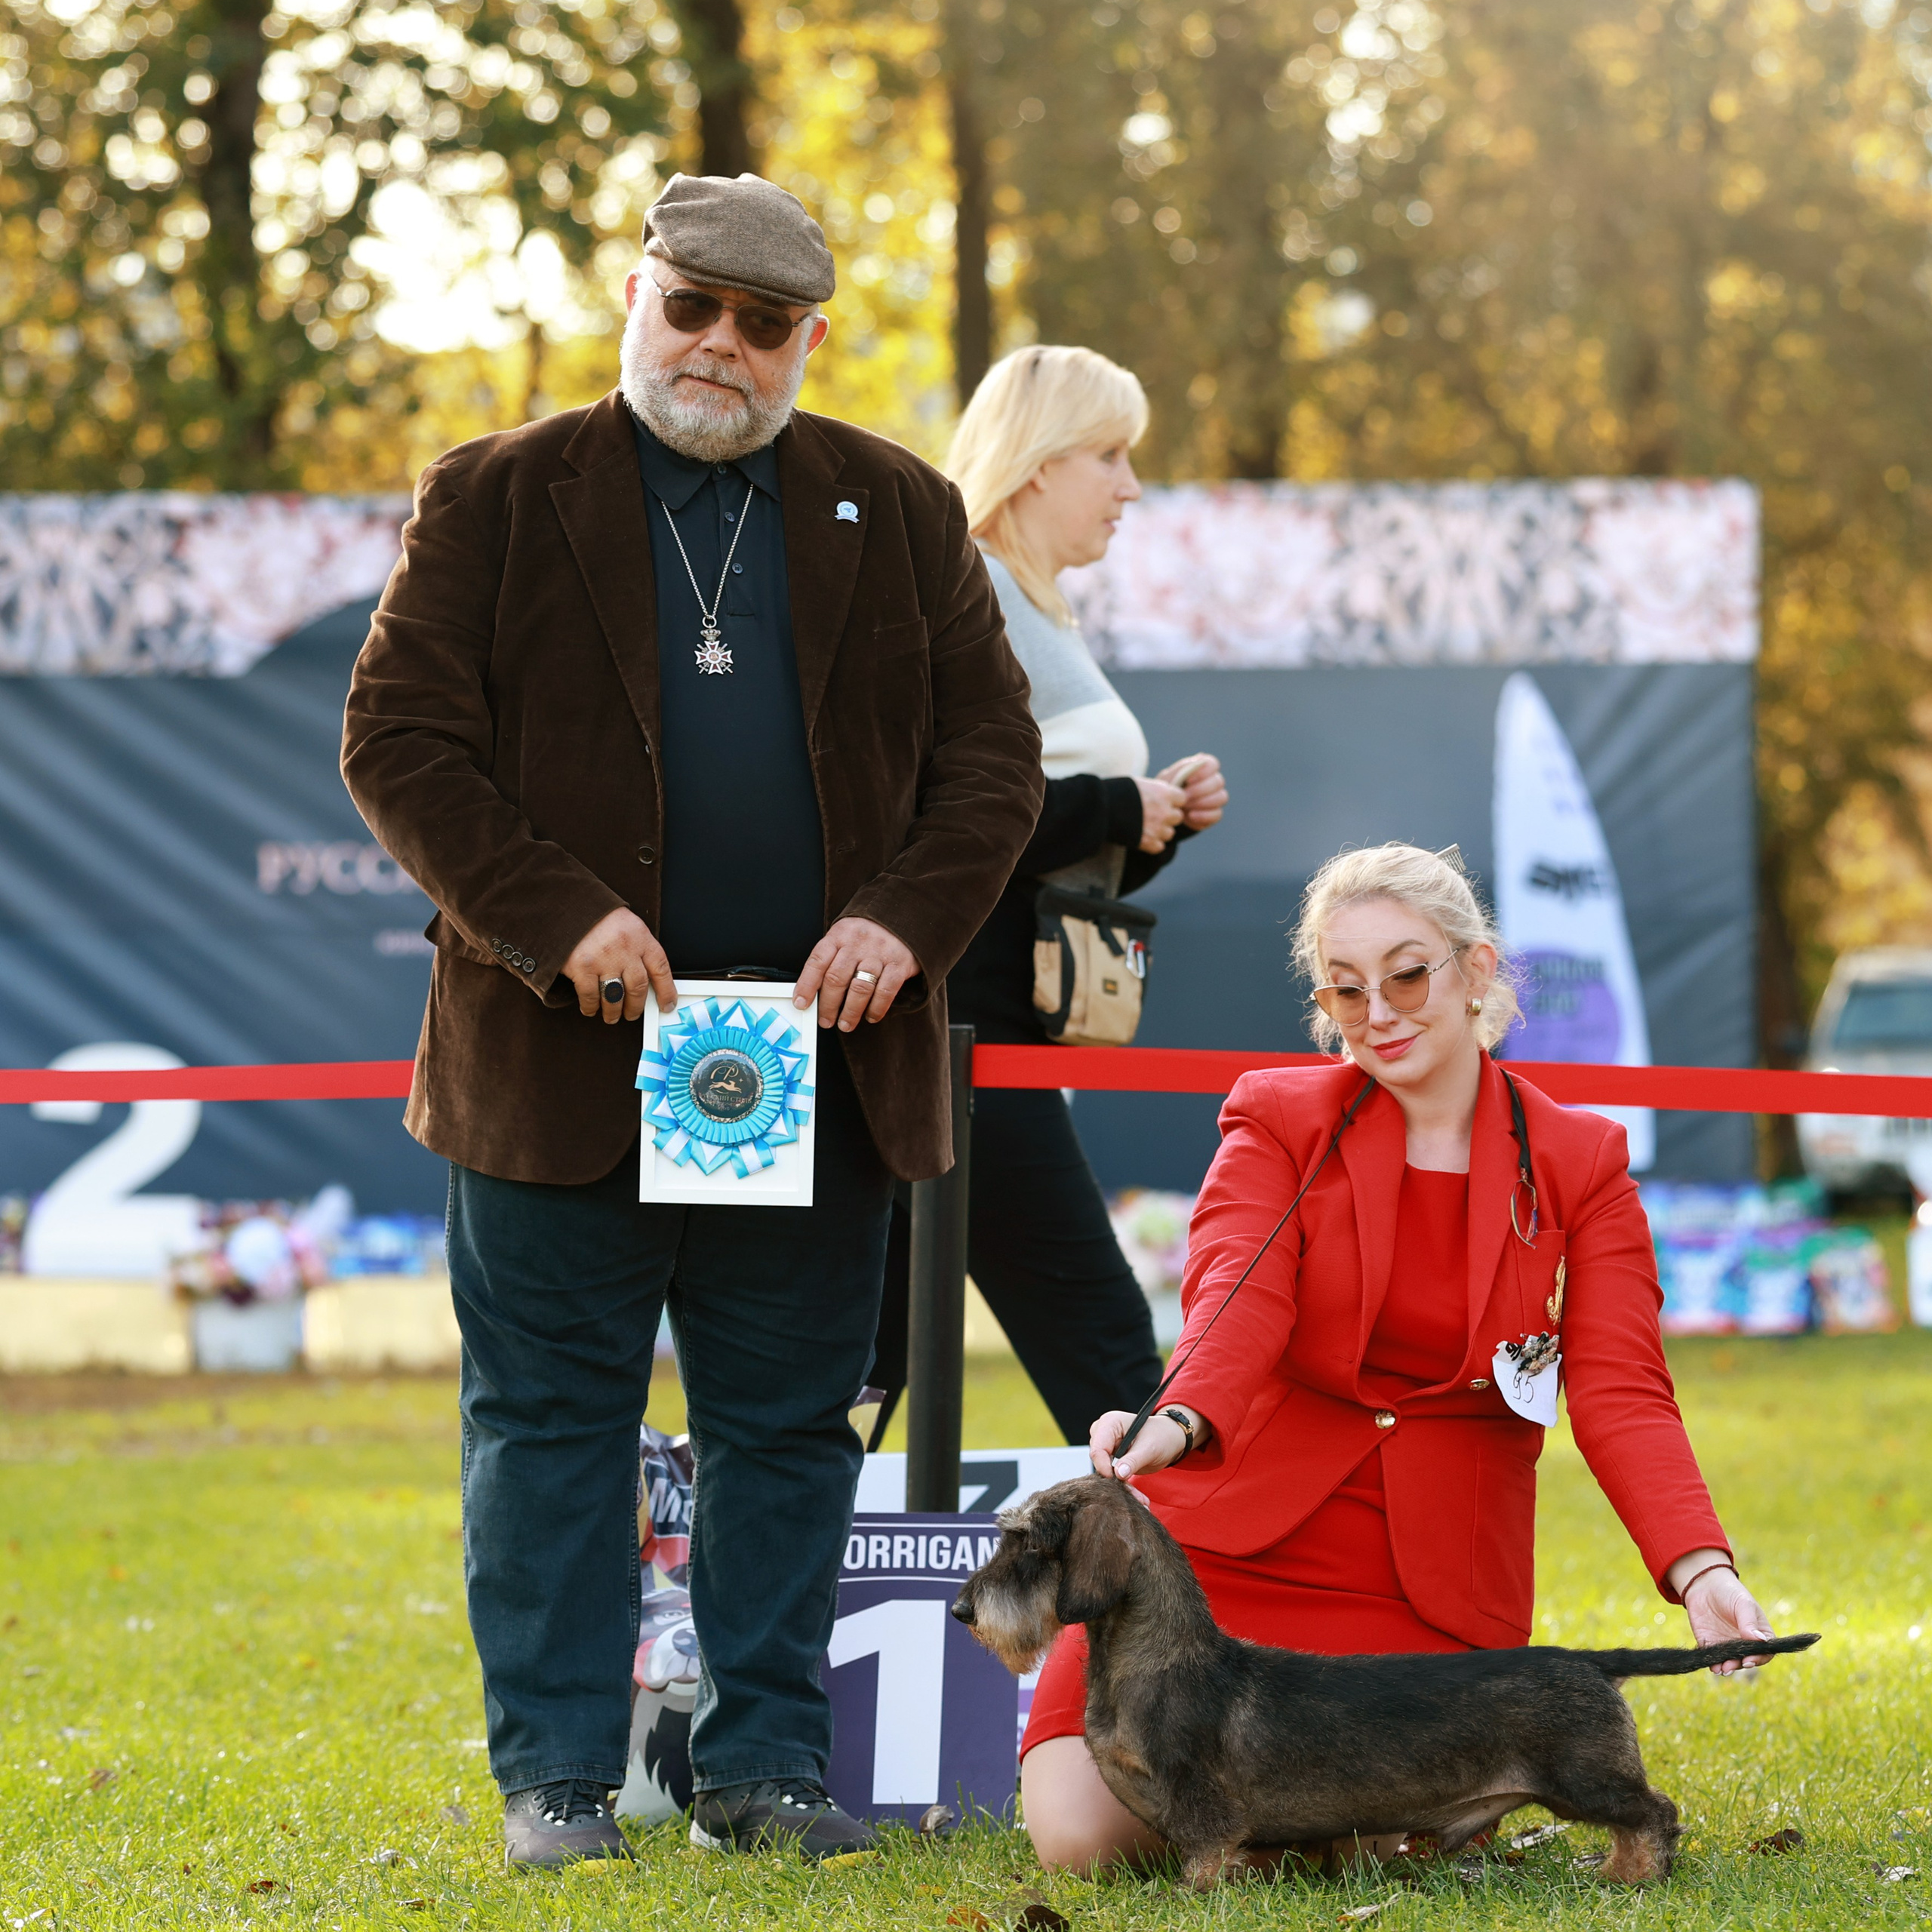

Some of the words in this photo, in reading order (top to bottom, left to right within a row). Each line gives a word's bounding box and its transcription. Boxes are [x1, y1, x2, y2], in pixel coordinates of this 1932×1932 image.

[257, 841, 417, 894] РУСС
[21, 1041, 202, 1277] 2
[1512, 1371, 1537, 1404] 95
[842, 1534, 1004, 1571] ORRIGAN
[827, 1599, 946, 1804] 1
